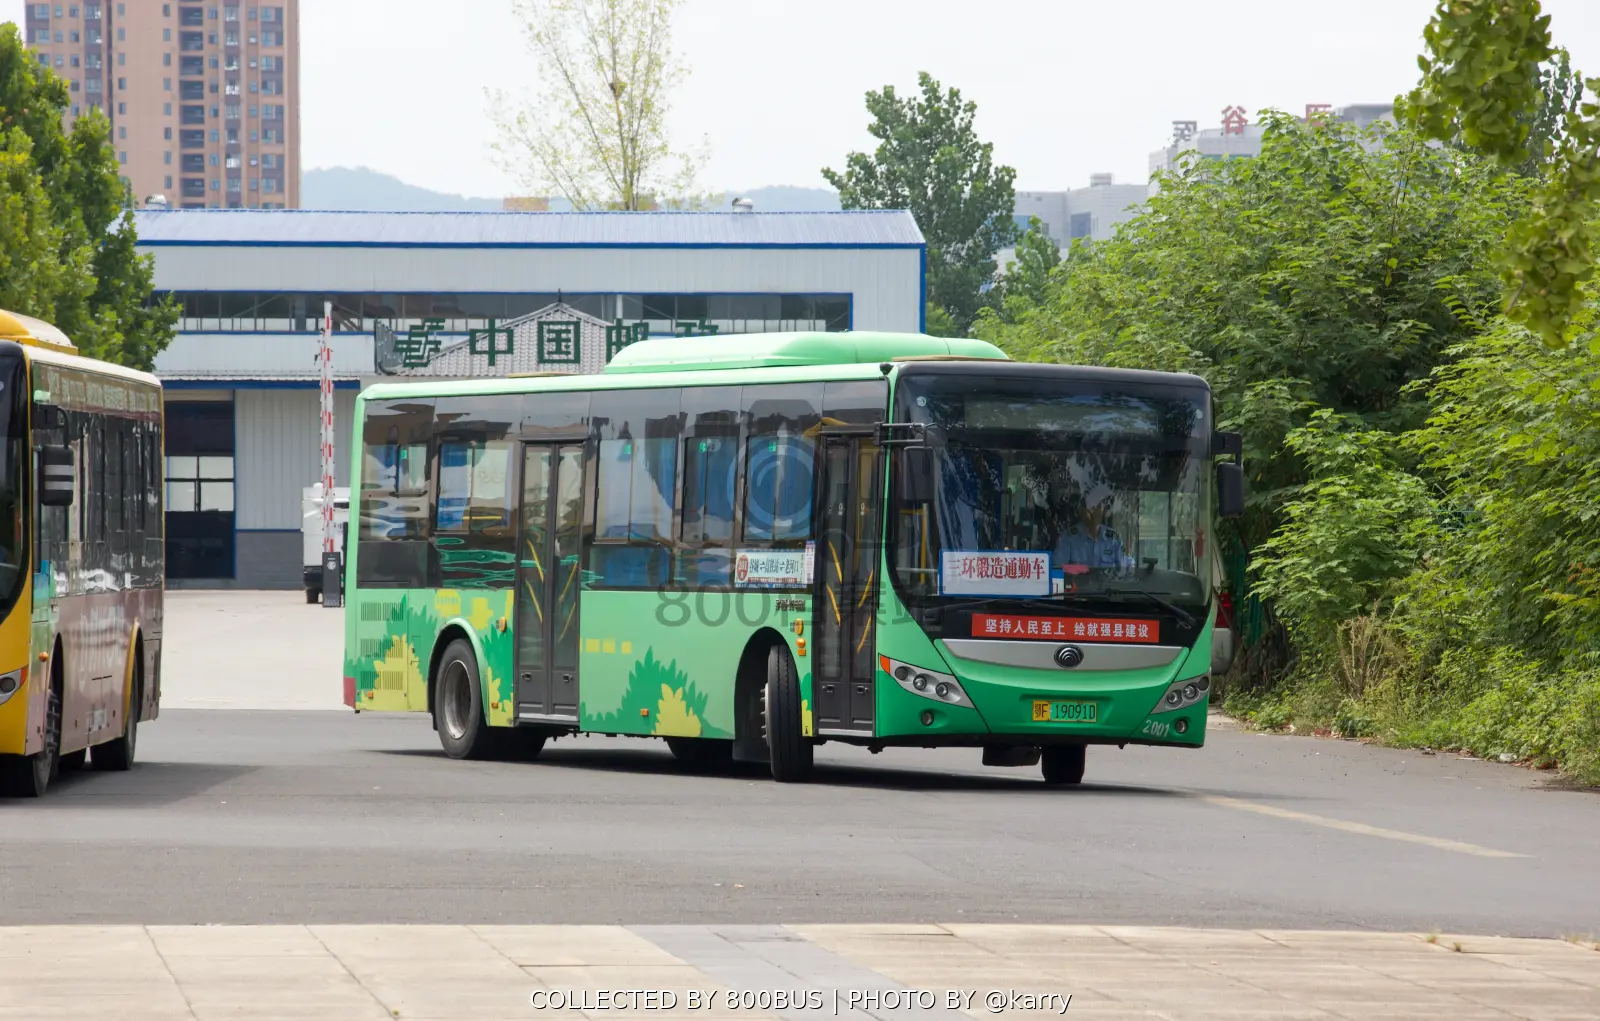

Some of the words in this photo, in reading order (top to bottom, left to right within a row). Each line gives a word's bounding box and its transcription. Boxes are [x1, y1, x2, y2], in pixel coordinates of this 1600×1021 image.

[985, 618, 1066, 636] 坚持人民至上
[1074, 621, 1149, 638] 绘就强县建设
[1142, 719, 1170, 737] 2001
